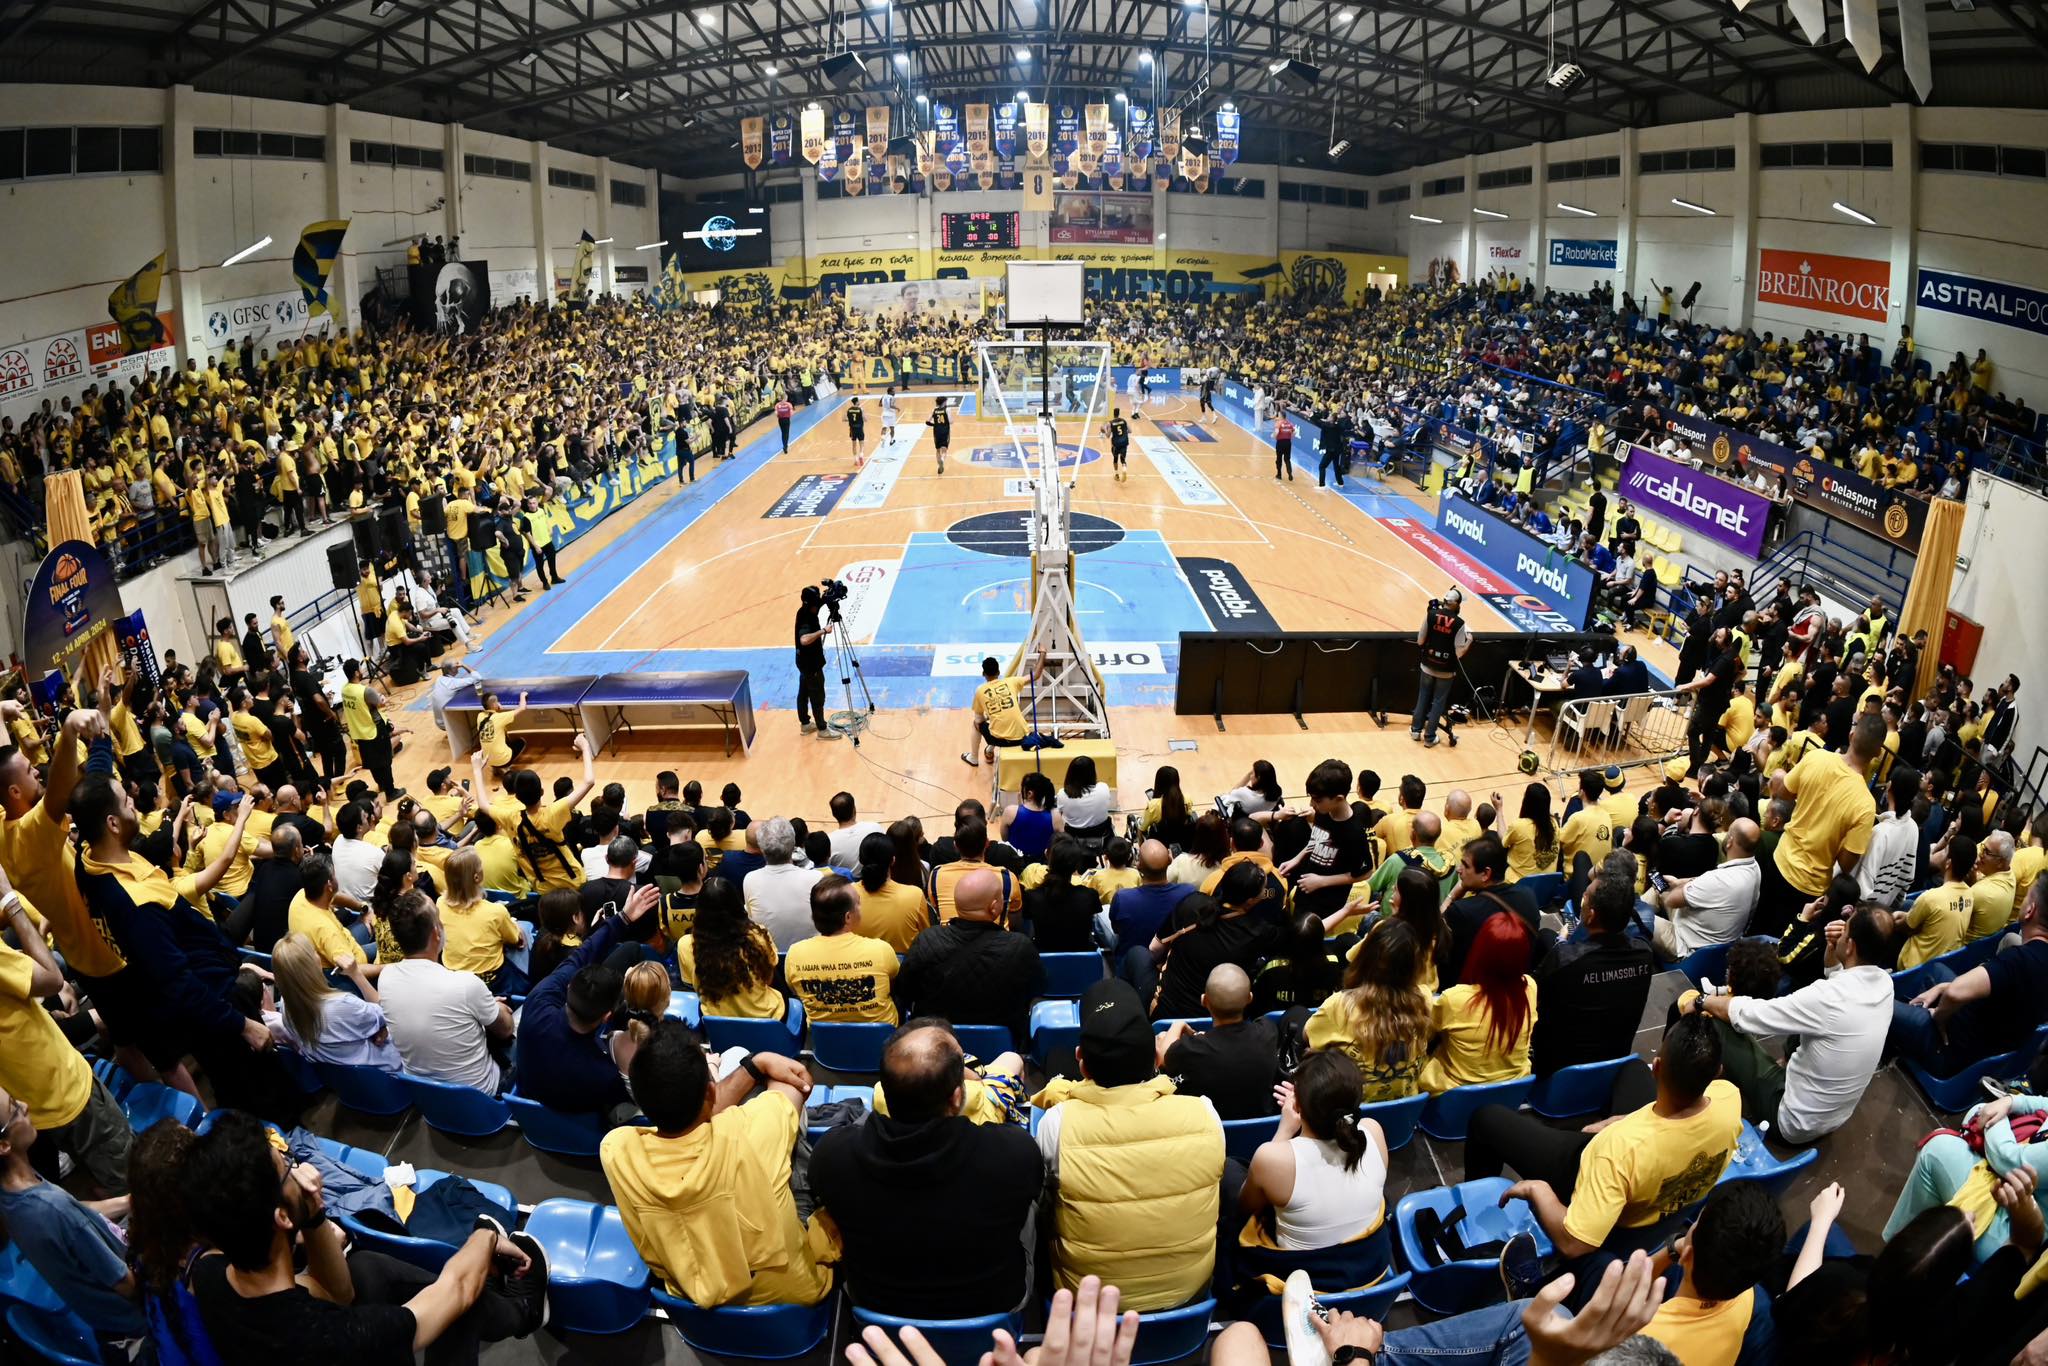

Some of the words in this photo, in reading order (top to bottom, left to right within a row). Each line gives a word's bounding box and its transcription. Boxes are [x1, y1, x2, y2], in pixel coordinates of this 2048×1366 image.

[1565, 246, 1618, 262] RoboMarkets
[1084, 268, 1213, 303] ΕΜΕΣΟΣ
[1759, 270, 1889, 313] BREINROCK
[233, 303, 271, 326] GFSC
[50, 363, 77, 378] MIA
[120, 351, 168, 366] PSALTIS
[1673, 421, 1707, 443] Delasport
[1645, 476, 1750, 537] cablenet
[1821, 492, 1829, 500] WE
[1830, 495, 1853, 510] DELIVER
[1854, 505, 1875, 520] SPORTS
[1831, 480, 1878, 510] Delasport
[1445, 509, 1488, 546] payabl.
[50, 583, 70, 606] FINAL
[70, 568, 89, 592] FOUR
[1516, 552, 1573, 601] payabl.
[1200, 570, 1257, 618] payabl.
[1435, 613, 1456, 627] TV
[52, 652, 61, 665] 12
[65, 642, 74, 655] 14
[74, 630, 91, 649] APRIL
[838, 963, 852, 971] ΣΤΟΝ
[1583, 972, 1600, 984] AEL
[1601, 966, 1638, 982] LIMASSOL
